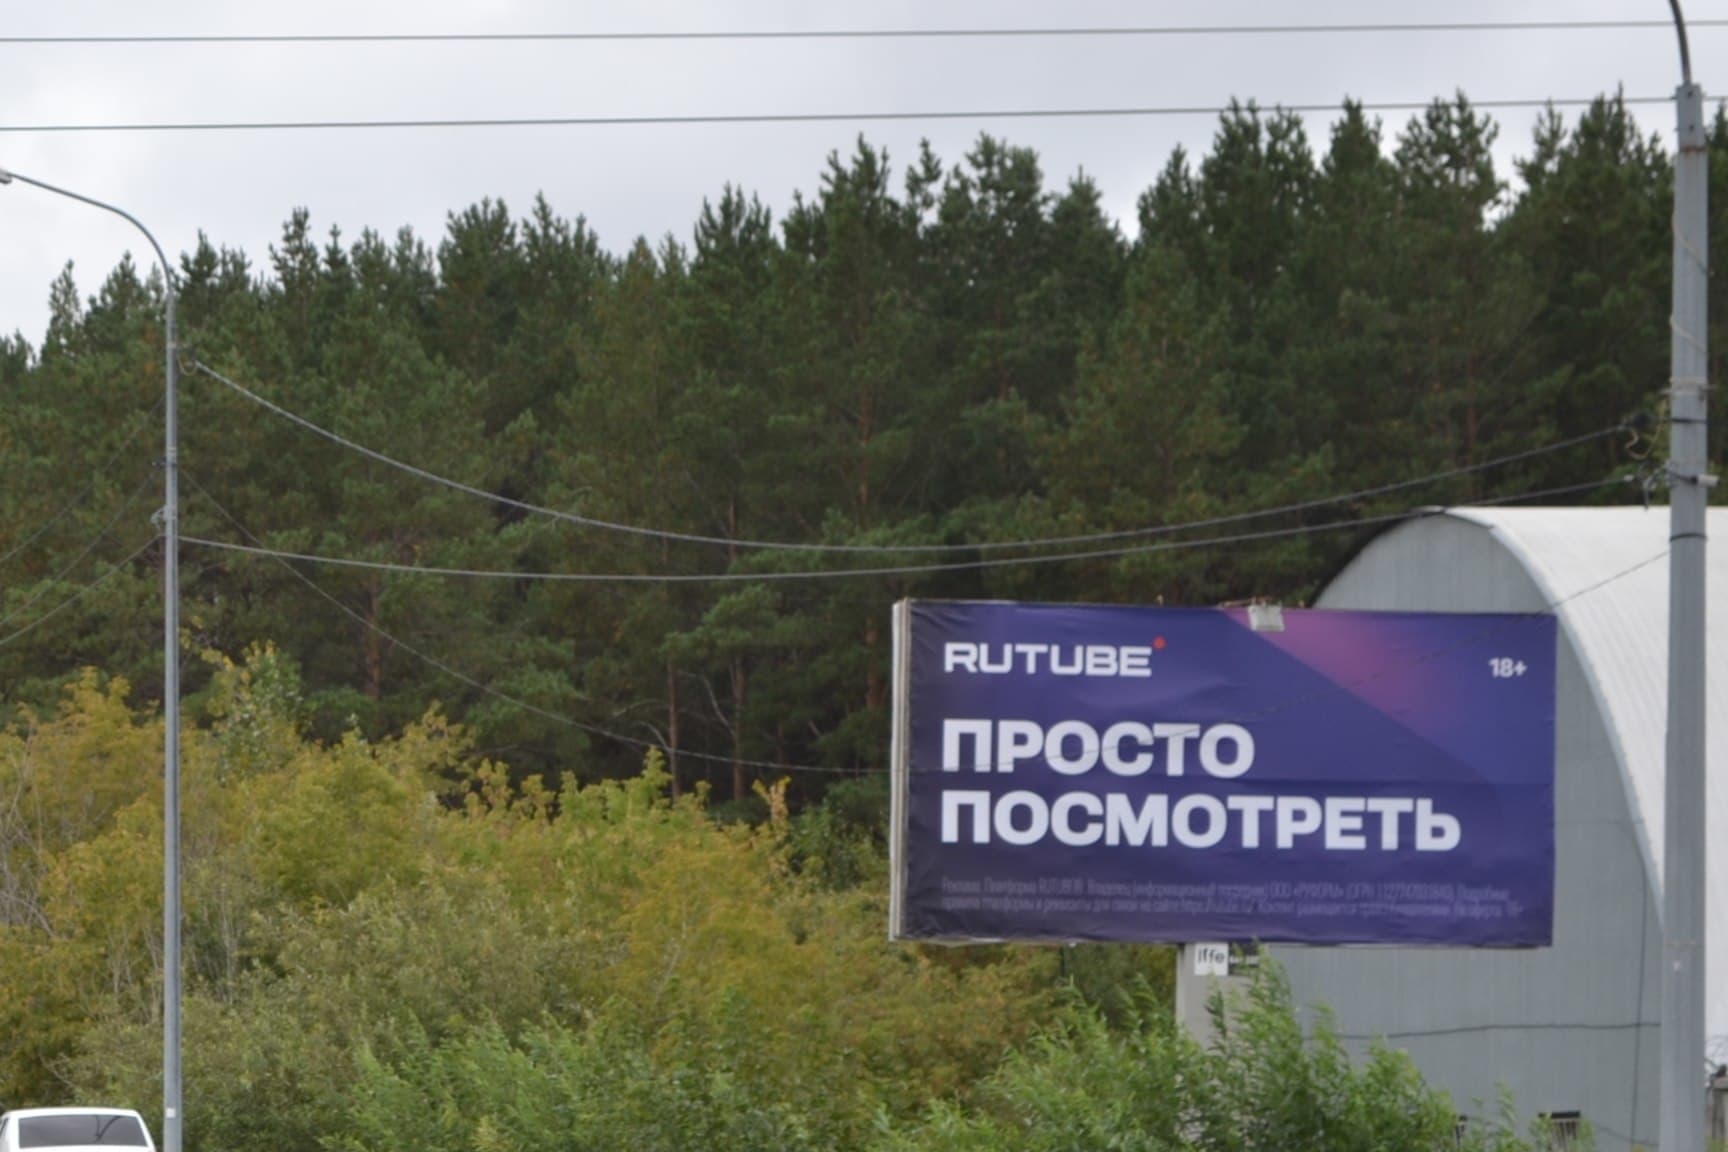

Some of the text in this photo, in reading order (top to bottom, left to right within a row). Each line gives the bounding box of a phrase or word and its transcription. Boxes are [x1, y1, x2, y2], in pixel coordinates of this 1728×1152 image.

[944, 642, 1153, 677] RUTUBE
[1489, 657, 1528, 678] 18+
[942, 718, 1255, 778] ПРОСТО
[941, 790, 1462, 851] ПОСМОТРЕТЬ
